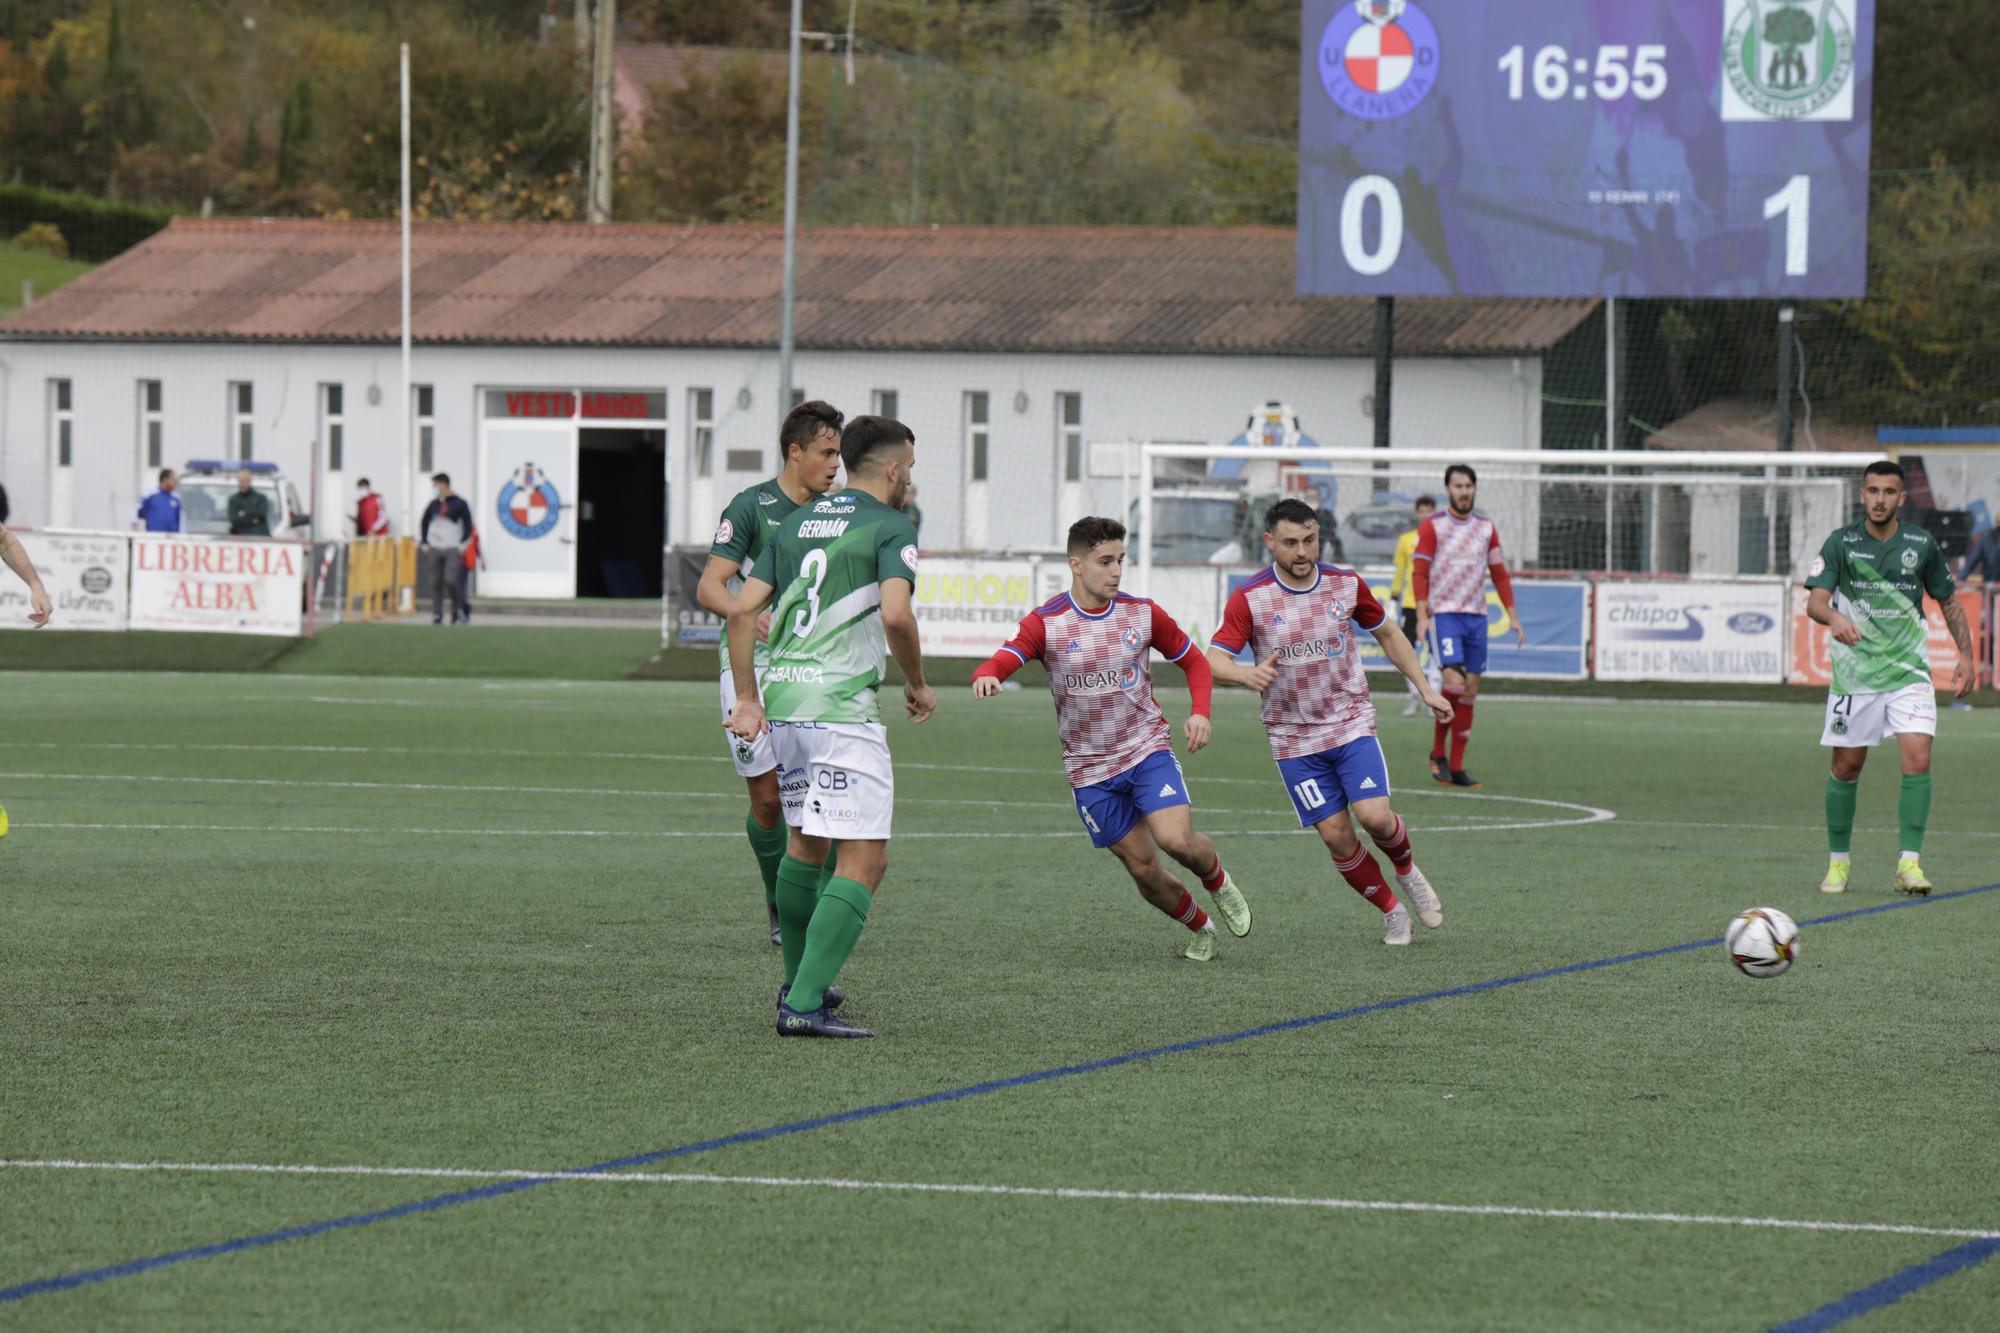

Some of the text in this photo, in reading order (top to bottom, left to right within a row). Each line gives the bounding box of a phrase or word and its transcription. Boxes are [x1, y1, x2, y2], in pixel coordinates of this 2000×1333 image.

[1326, 47, 1433, 66] U D
[1498, 45, 1668, 101] 16:55
[1329, 78, 1427, 114] LLANERA
[1340, 175, 1404, 275] 0
[1764, 175, 1810, 276] 1
[507, 392, 649, 418] VESTUARIOS
[798, 517, 850, 539] GERMÁN
[137, 542, 295, 576] LIBRERIA
[170, 581, 258, 611] ALBA
[792, 549, 828, 639] 3
[917, 574, 1030, 605] UNION
[1274, 640, 1325, 660] DICAR
[1442, 638, 1455, 656] 3
[1066, 670, 1119, 689] DICAR
[818, 770, 848, 790] OB
[1294, 778, 1327, 811] 10
